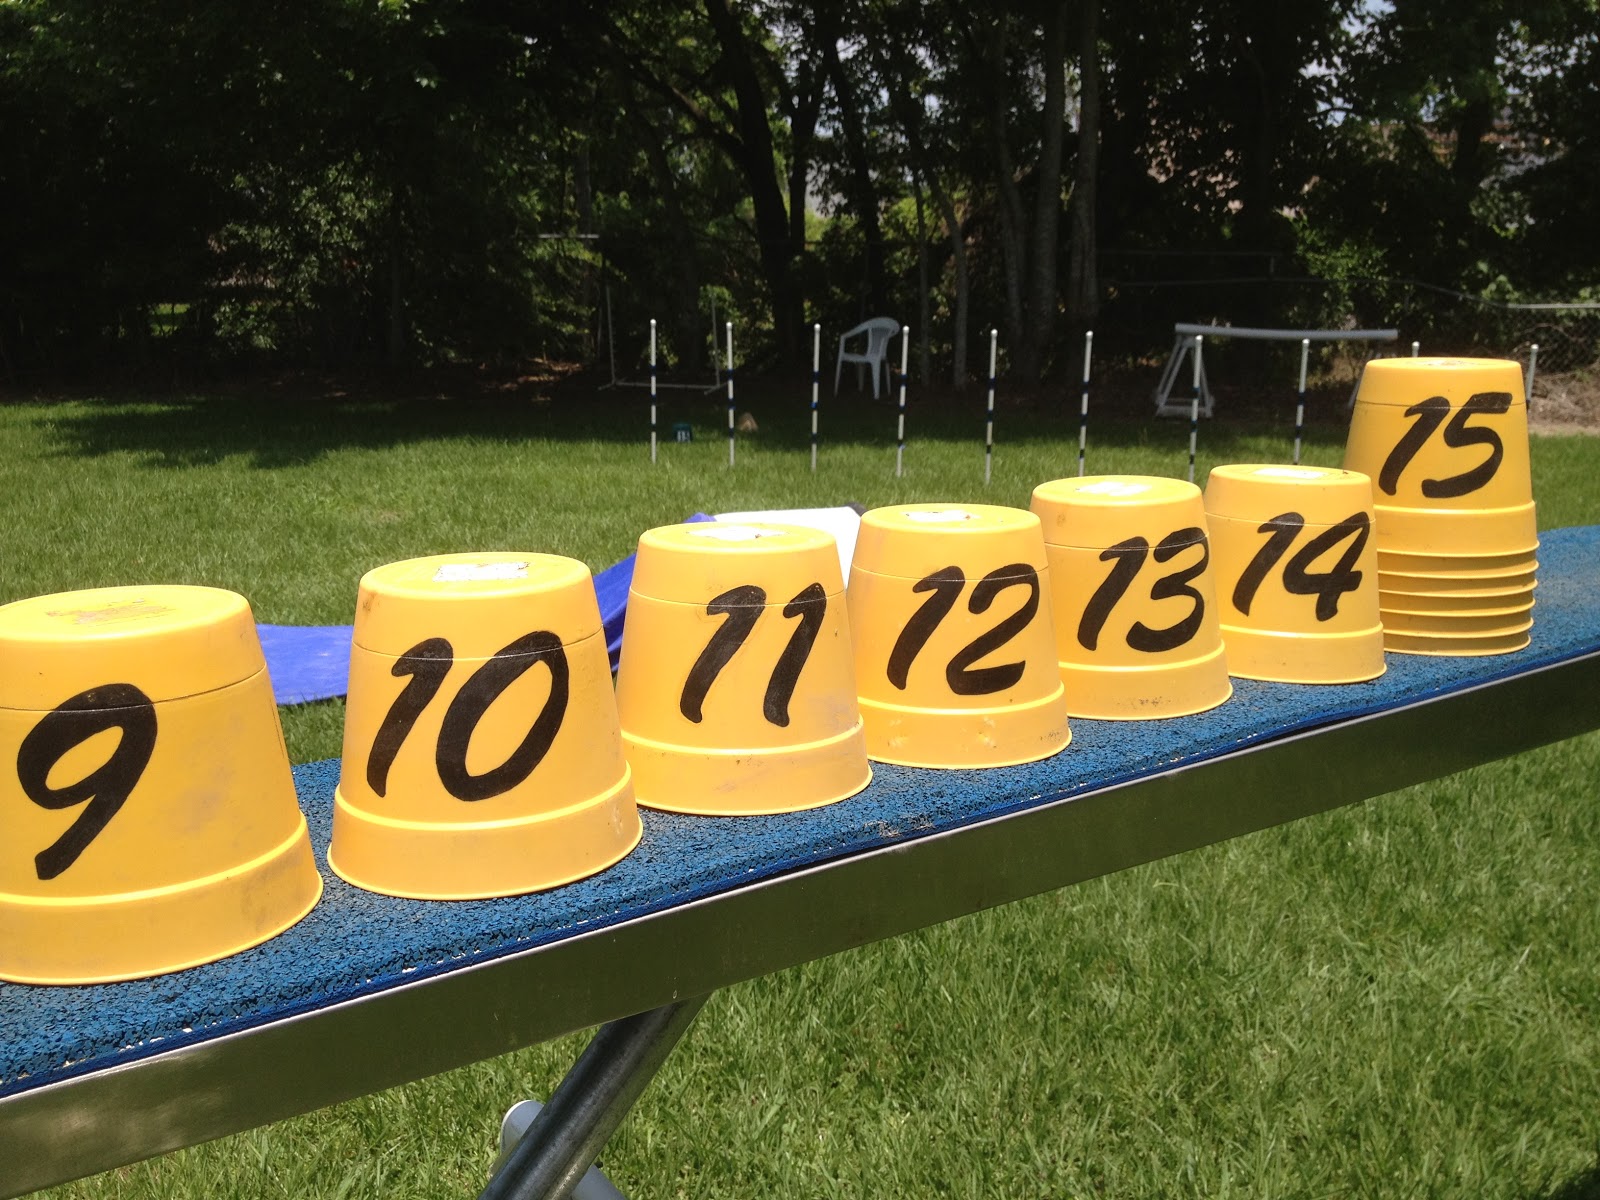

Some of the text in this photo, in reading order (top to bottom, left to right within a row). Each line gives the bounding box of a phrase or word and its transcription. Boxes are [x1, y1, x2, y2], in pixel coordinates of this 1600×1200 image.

[1378, 391, 1512, 499] 15
[886, 563, 1040, 696] 12
[1077, 527, 1209, 653] 13
[1232, 511, 1371, 622] 14
[366, 630, 570, 802] 10
[680, 582, 827, 728] 11
[16, 683, 158, 880] 9
